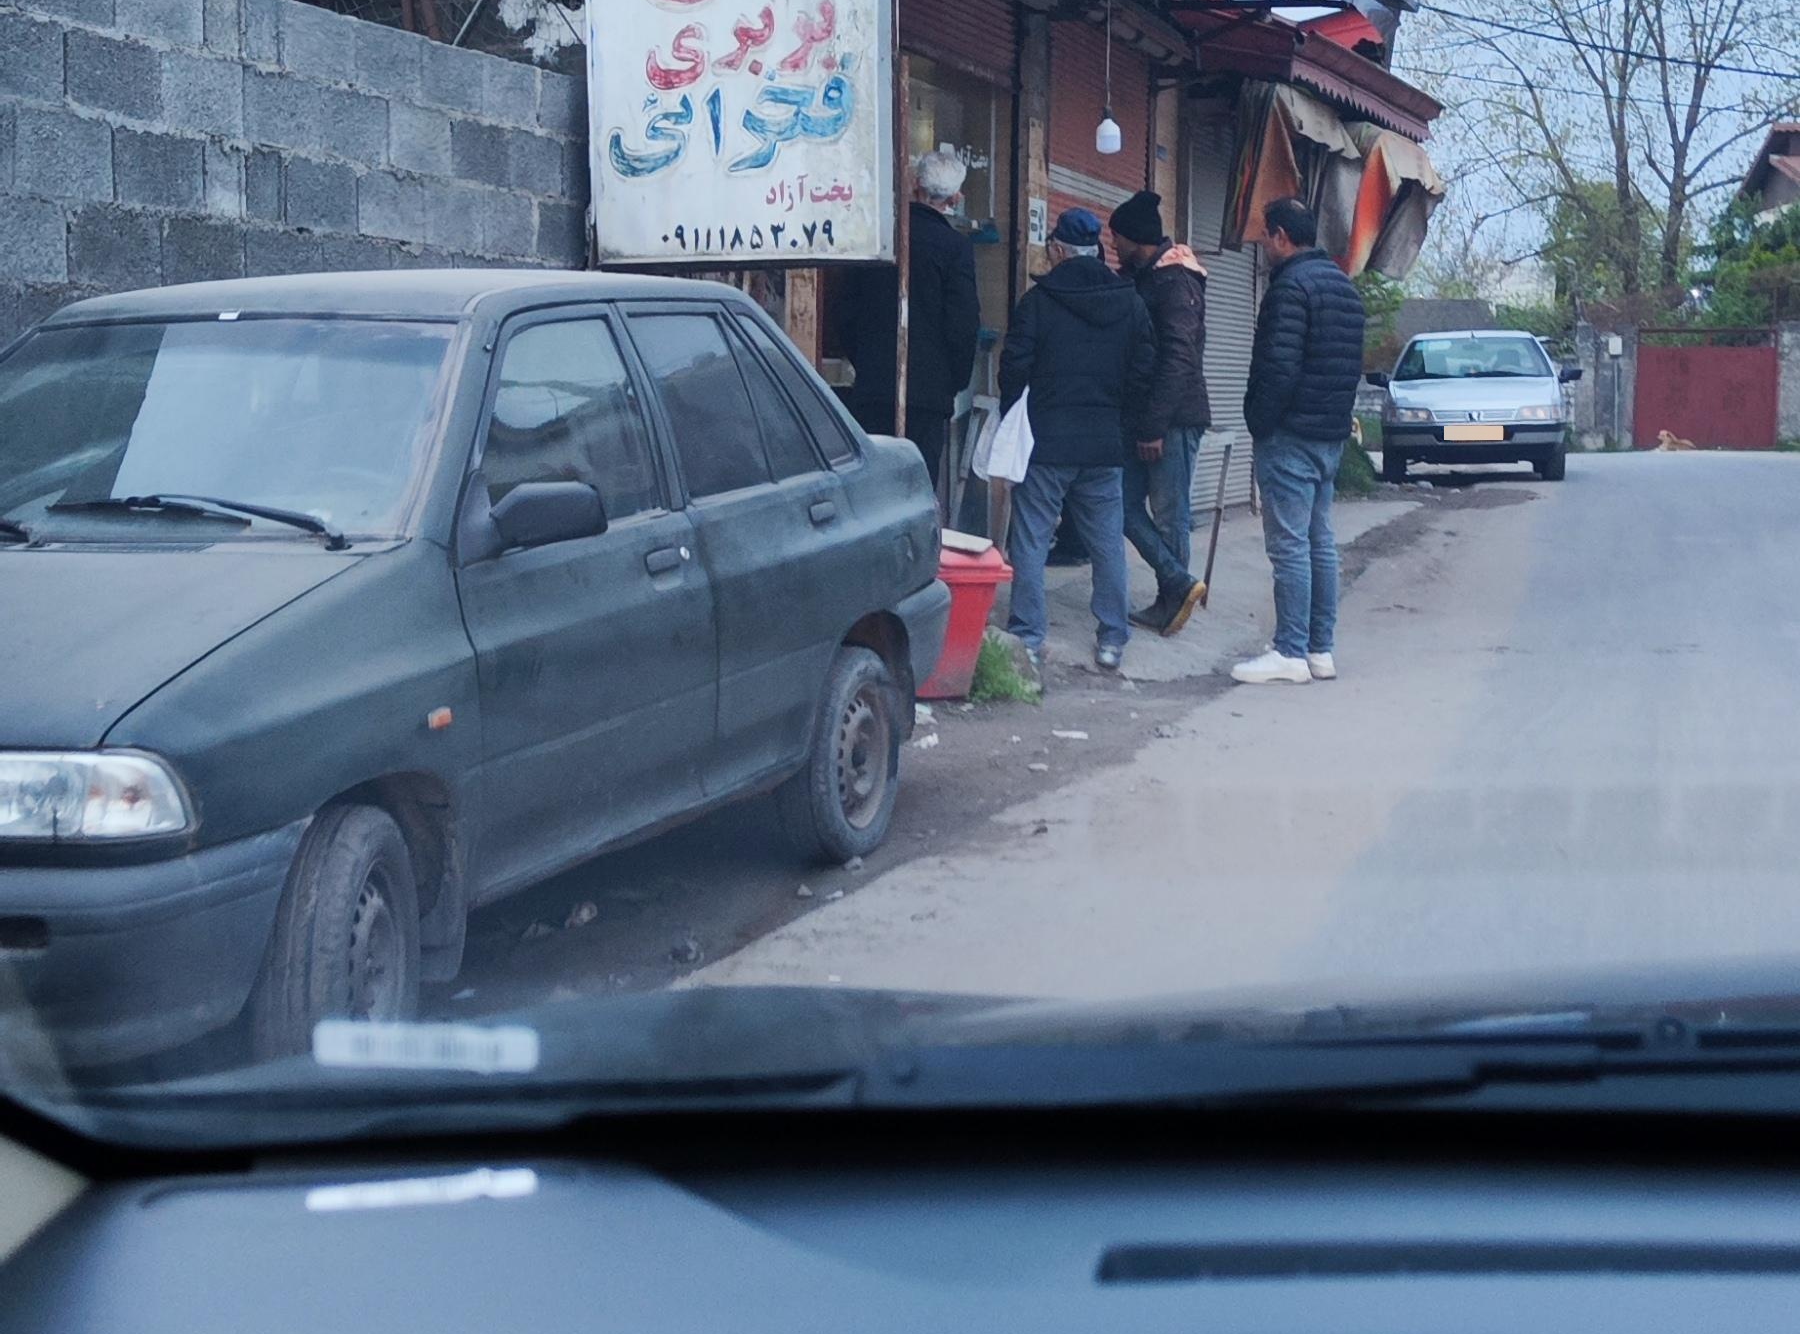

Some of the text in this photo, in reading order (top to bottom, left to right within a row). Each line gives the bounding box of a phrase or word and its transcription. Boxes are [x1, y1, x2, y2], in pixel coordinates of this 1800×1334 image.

[646, 0, 838, 90] بربری
[766, 173, 853, 213] پخت آزاد
[661, 219, 834, 251] ۰۹۱۱۱۸۵۳۰۷۹
